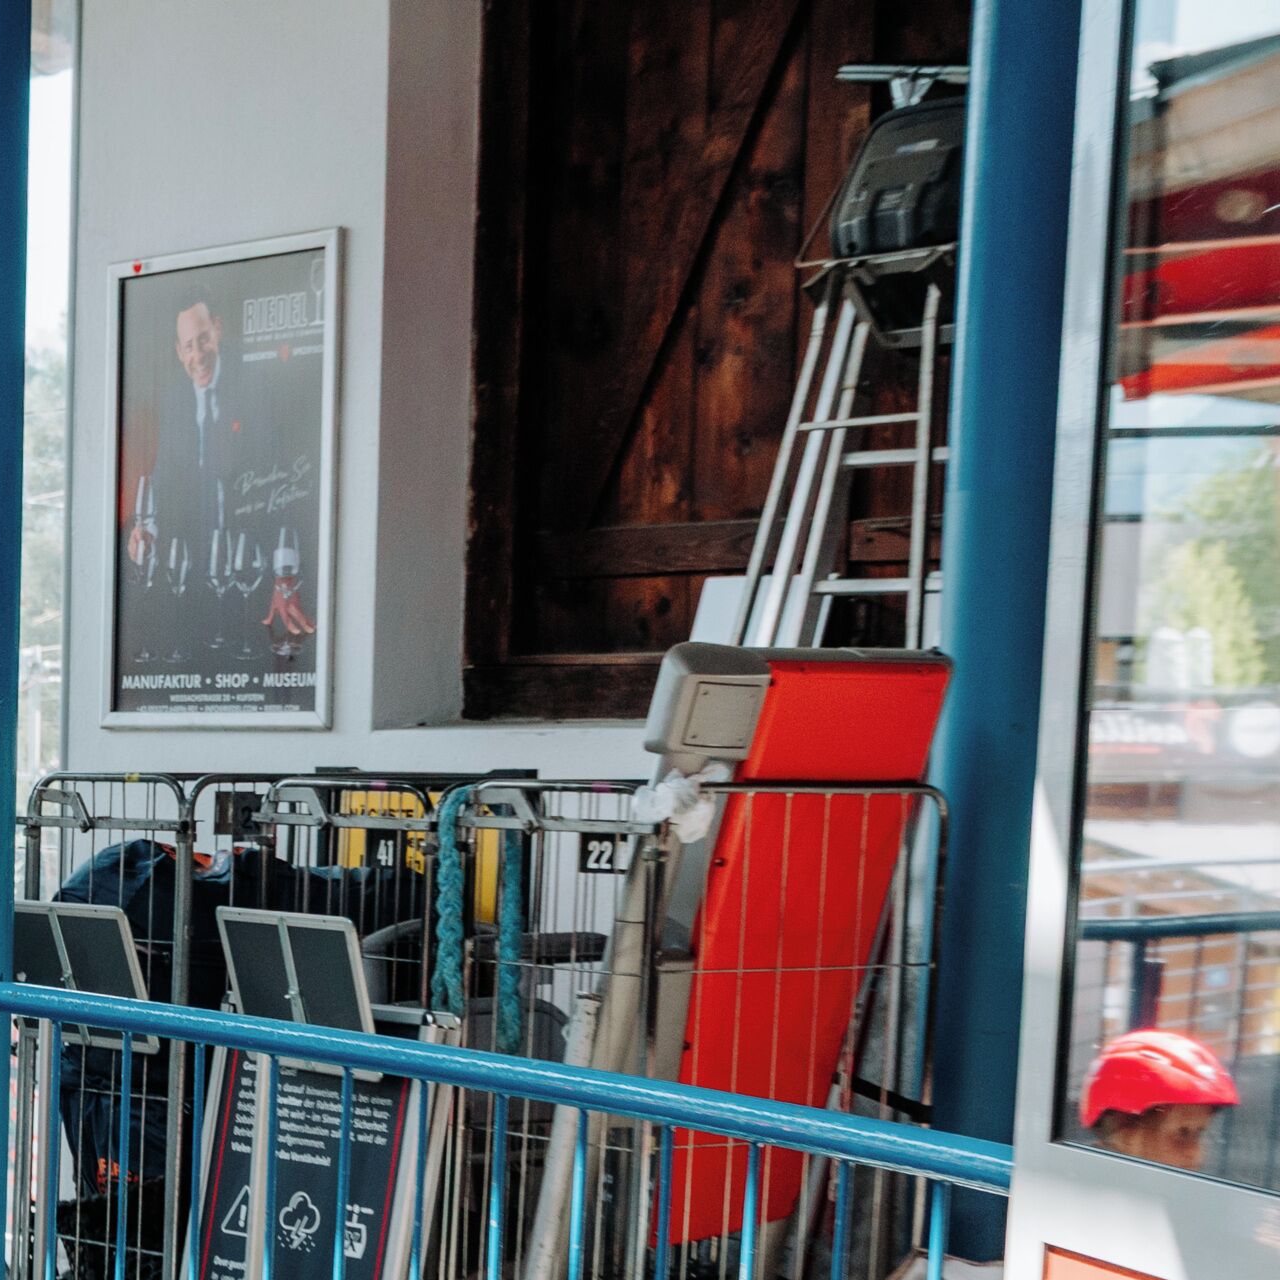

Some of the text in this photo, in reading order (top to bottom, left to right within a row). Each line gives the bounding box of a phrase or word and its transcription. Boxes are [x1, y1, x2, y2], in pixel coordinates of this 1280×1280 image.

[122, 672, 317, 689] MANUFAKTUR SHOP MUSEUM
[376, 839, 394, 867] 41
[587, 840, 613, 869] 22
